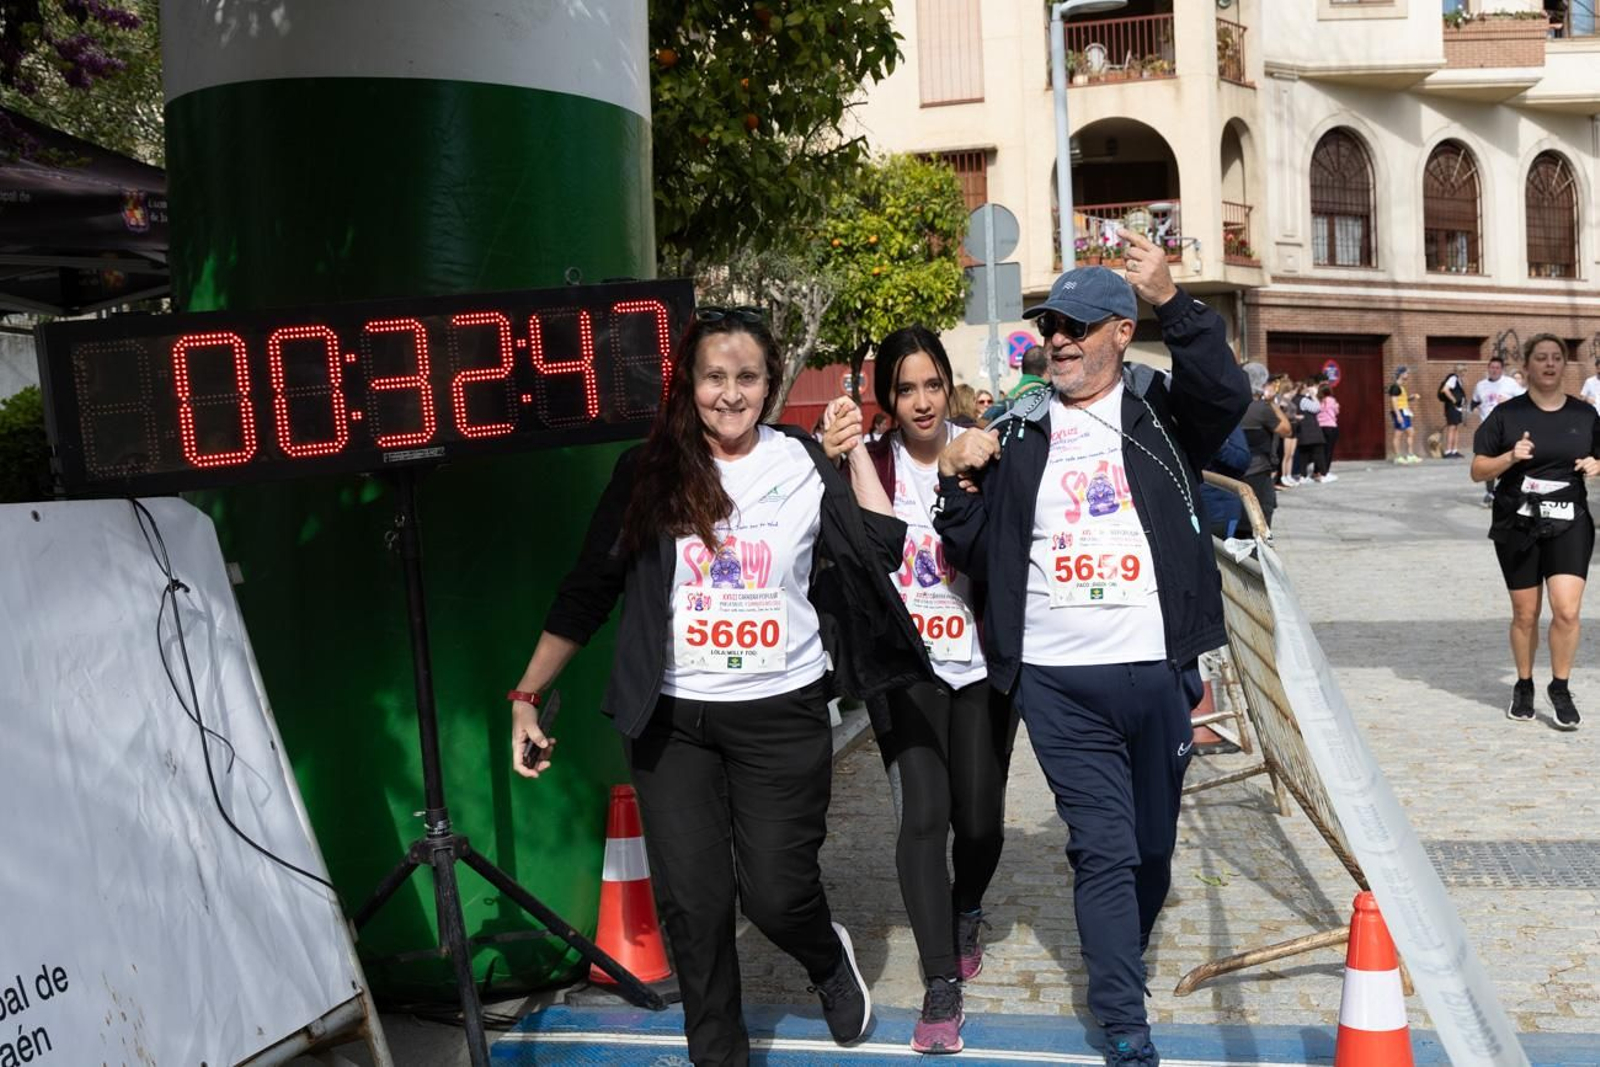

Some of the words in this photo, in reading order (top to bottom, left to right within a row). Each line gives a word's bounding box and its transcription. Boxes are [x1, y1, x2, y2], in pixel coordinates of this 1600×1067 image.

[172, 300, 673, 467] 00:32:47
[1055, 554, 1140, 582] 5659
[686, 619, 780, 648] 5660
[35, 963, 69, 1000] de
[0, 1023, 52, 1067] aén
